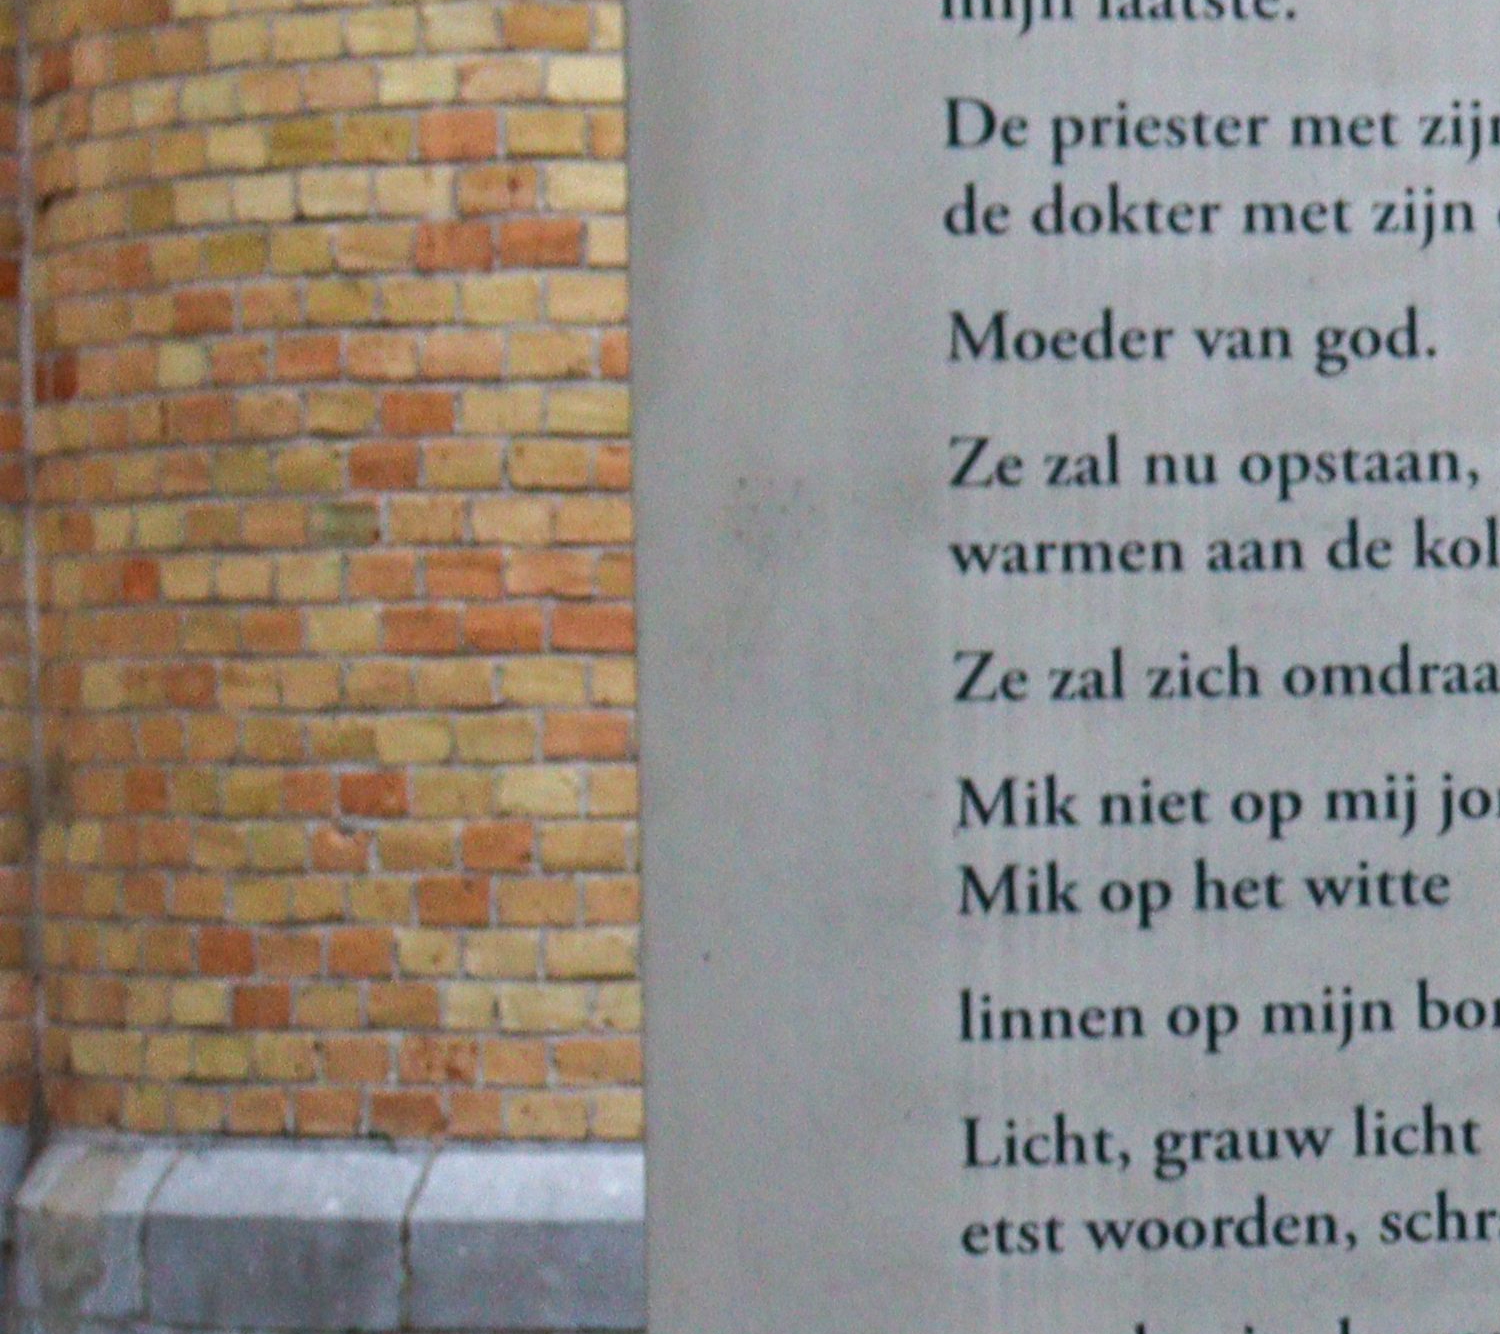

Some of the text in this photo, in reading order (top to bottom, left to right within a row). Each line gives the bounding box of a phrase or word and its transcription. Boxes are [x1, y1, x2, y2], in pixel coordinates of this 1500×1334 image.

[944, 94, 1031, 151] De
[1049, 98, 1271, 169] priester
[1289, 110, 1399, 151] met
[941, 180, 1012, 239] de
[1028, 179, 1224, 238] dokter
[1241, 196, 1352, 237] met
[1372, 184, 1477, 252] zijn
[947, 301, 1438, 380] Moeder van god.
[948, 434, 1026, 490] Ze
[1043, 430, 1122, 490] zal
[1143, 451, 1220, 488] nu
[1237, 446, 1482, 505] opstaan,
[947, 538, 1186, 577] warmen
[1205, 536, 1307, 575] aan
[1324, 514, 1395, 574] de
[952, 648, 1031, 705] Ze
[1047, 644, 1127, 704] zal
[1145, 642, 1263, 702] zich
[956, 771, 1080, 831] Mik
[1098, 775, 1211, 829] niet
[1228, 787, 1305, 843] op
[1324, 770, 1419, 839] mij
[957, 855, 1452, 933] Mik op het witte
[958, 985, 1147, 1044] linnen
[1164, 1001, 1242, 1057] op
[1261, 983, 1396, 1051] mijn
[961, 1099, 1482, 1184] Licht, grauw licht
[959, 1215, 1065, 1258] etst
[1082, 1191, 1360, 1254] woorden,
